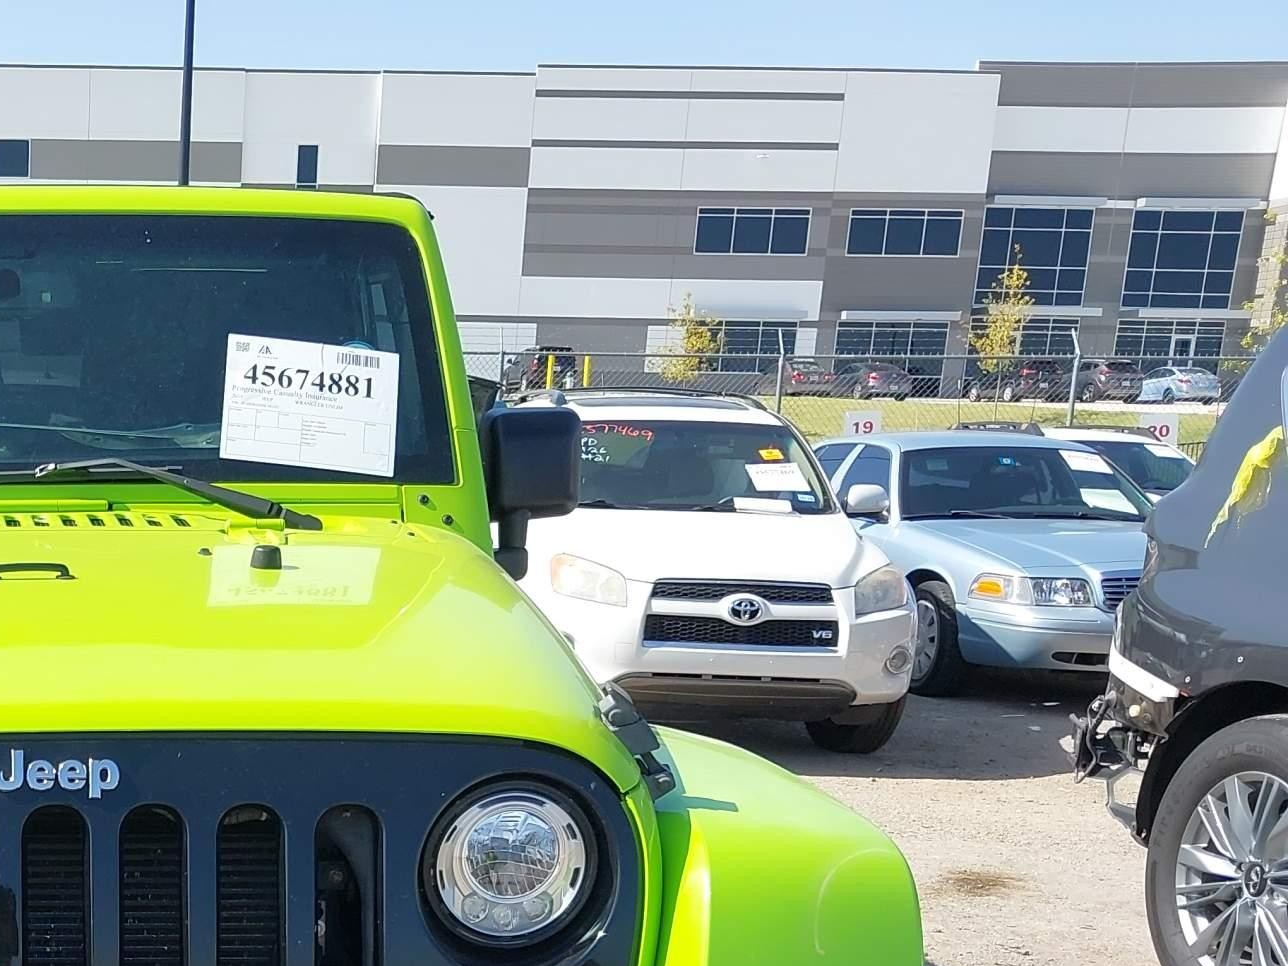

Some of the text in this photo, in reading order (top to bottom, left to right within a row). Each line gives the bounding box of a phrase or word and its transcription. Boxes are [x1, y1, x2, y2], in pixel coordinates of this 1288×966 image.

[243, 363, 375, 399] 45674881
[231, 385, 272, 395] Progressive
[852, 420, 873, 434] 19
[811, 630, 833, 639] V6
